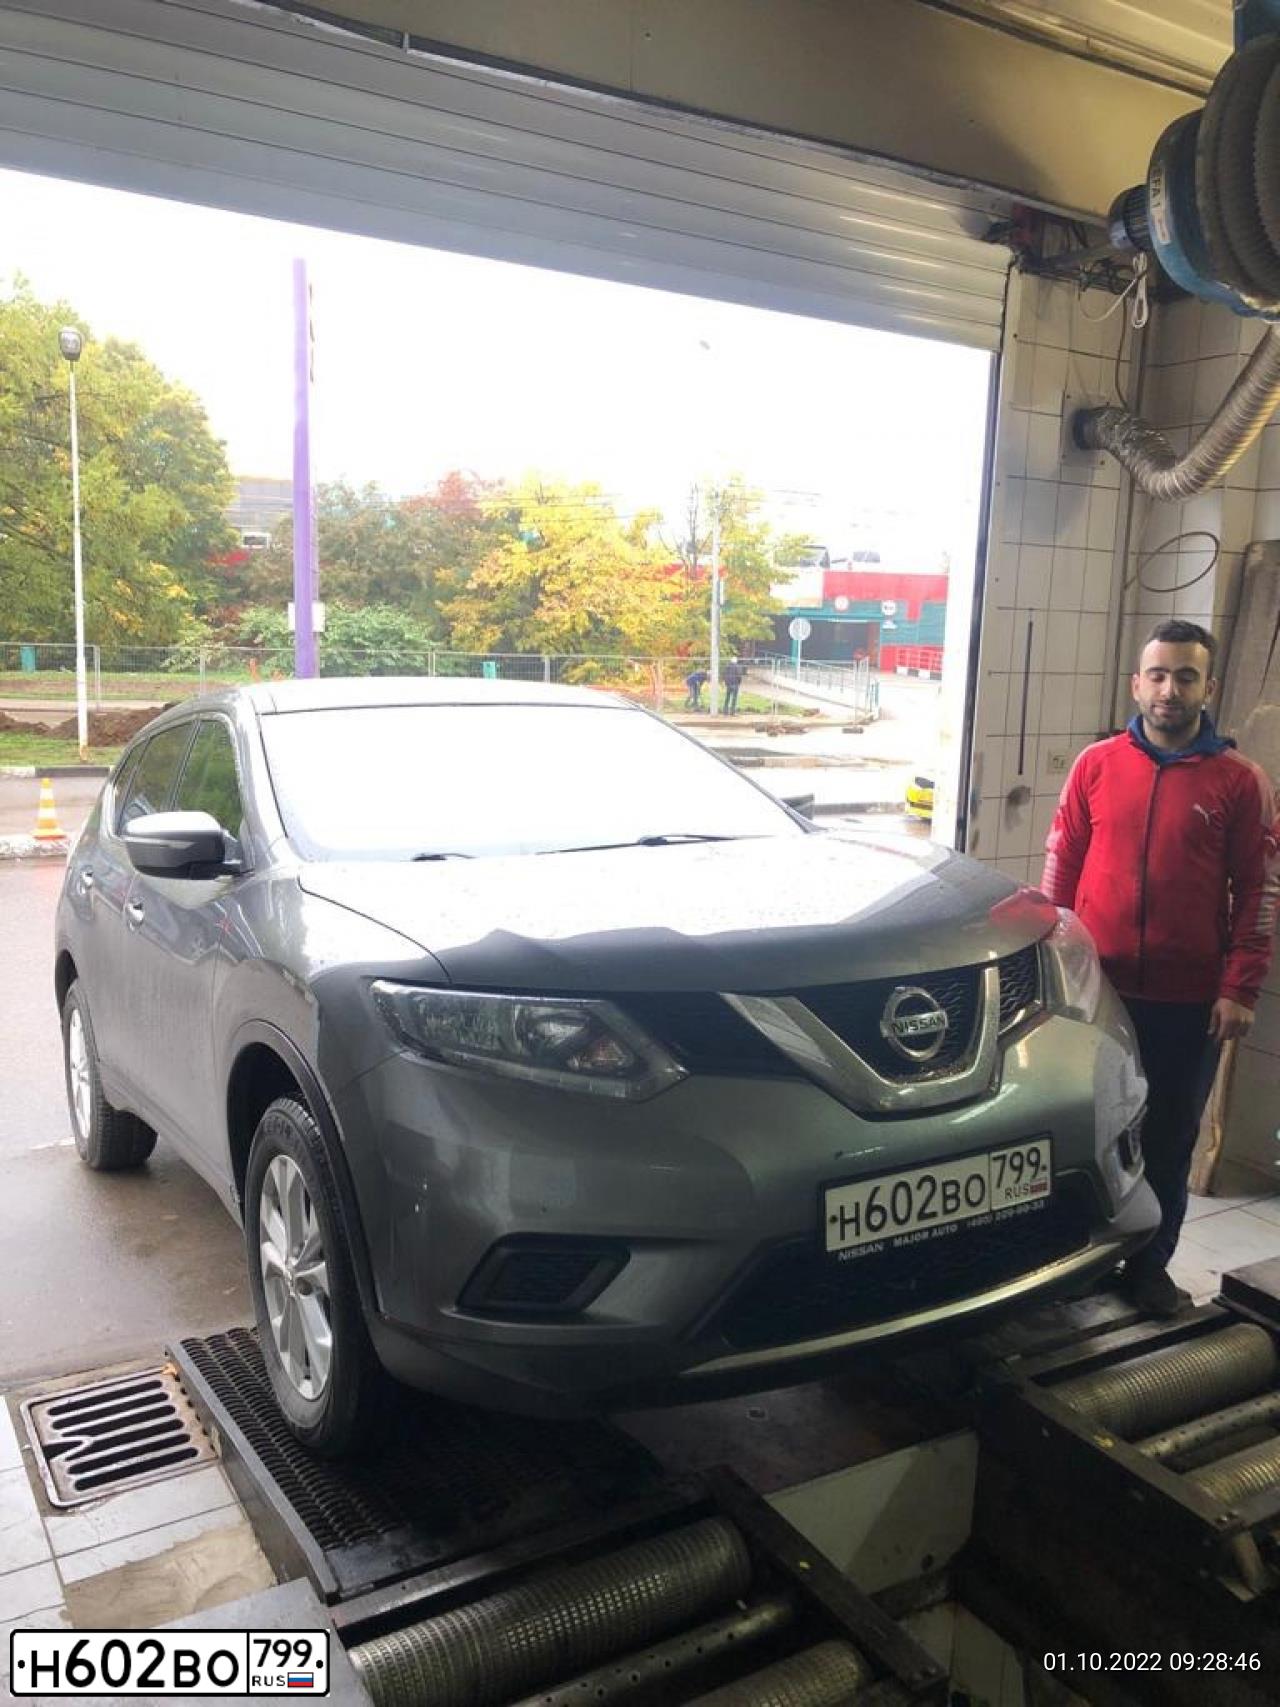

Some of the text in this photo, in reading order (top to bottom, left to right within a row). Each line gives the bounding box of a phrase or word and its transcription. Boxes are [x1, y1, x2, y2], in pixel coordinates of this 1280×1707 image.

[891, 1016, 945, 1033] NISSAN
[993, 1146, 1042, 1190] 799
[1004, 1183, 1030, 1201] RUS
[838, 1224, 958, 1261] NISSAN MAJOR AUTO
